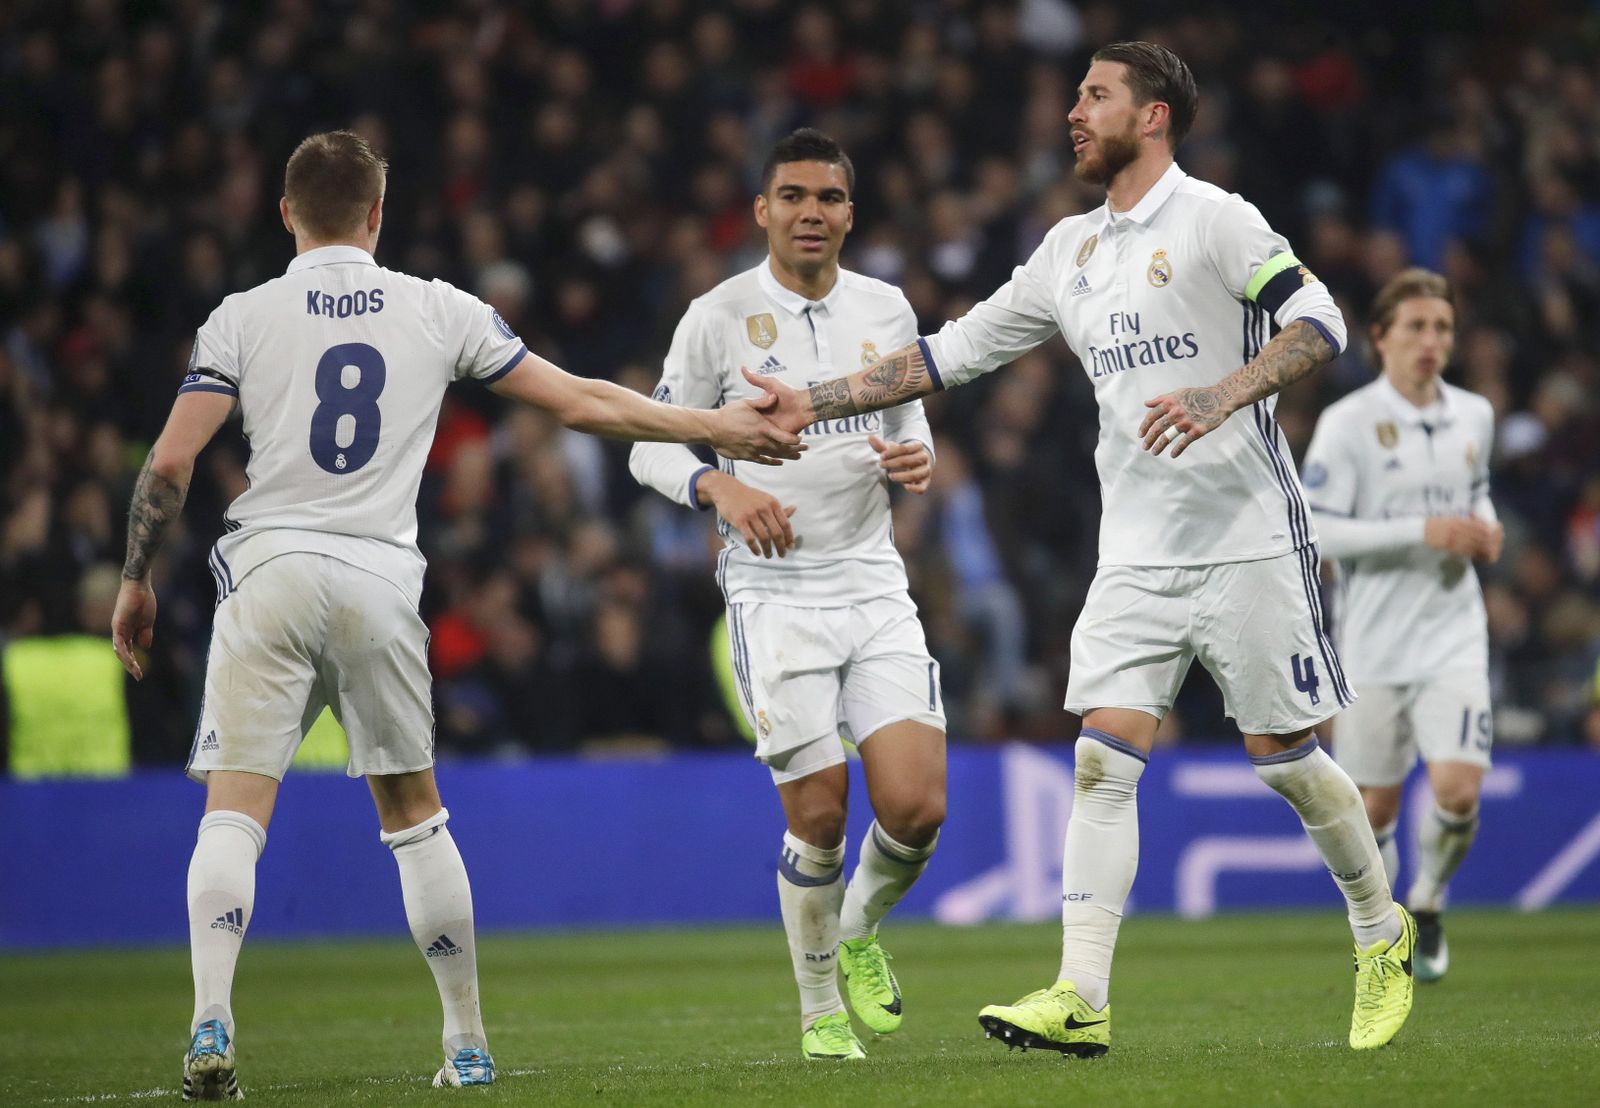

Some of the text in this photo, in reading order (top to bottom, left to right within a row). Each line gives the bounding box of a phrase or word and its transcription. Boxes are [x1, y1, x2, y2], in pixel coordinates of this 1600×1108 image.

[306, 288, 385, 319] KROOS
[1109, 311, 1140, 336] Fly
[1088, 332, 1199, 378] Emirates
[309, 342, 386, 475] 8
[1291, 653, 1320, 706] 4
[210, 921, 244, 938] adidas
[426, 946, 463, 957] adidas
